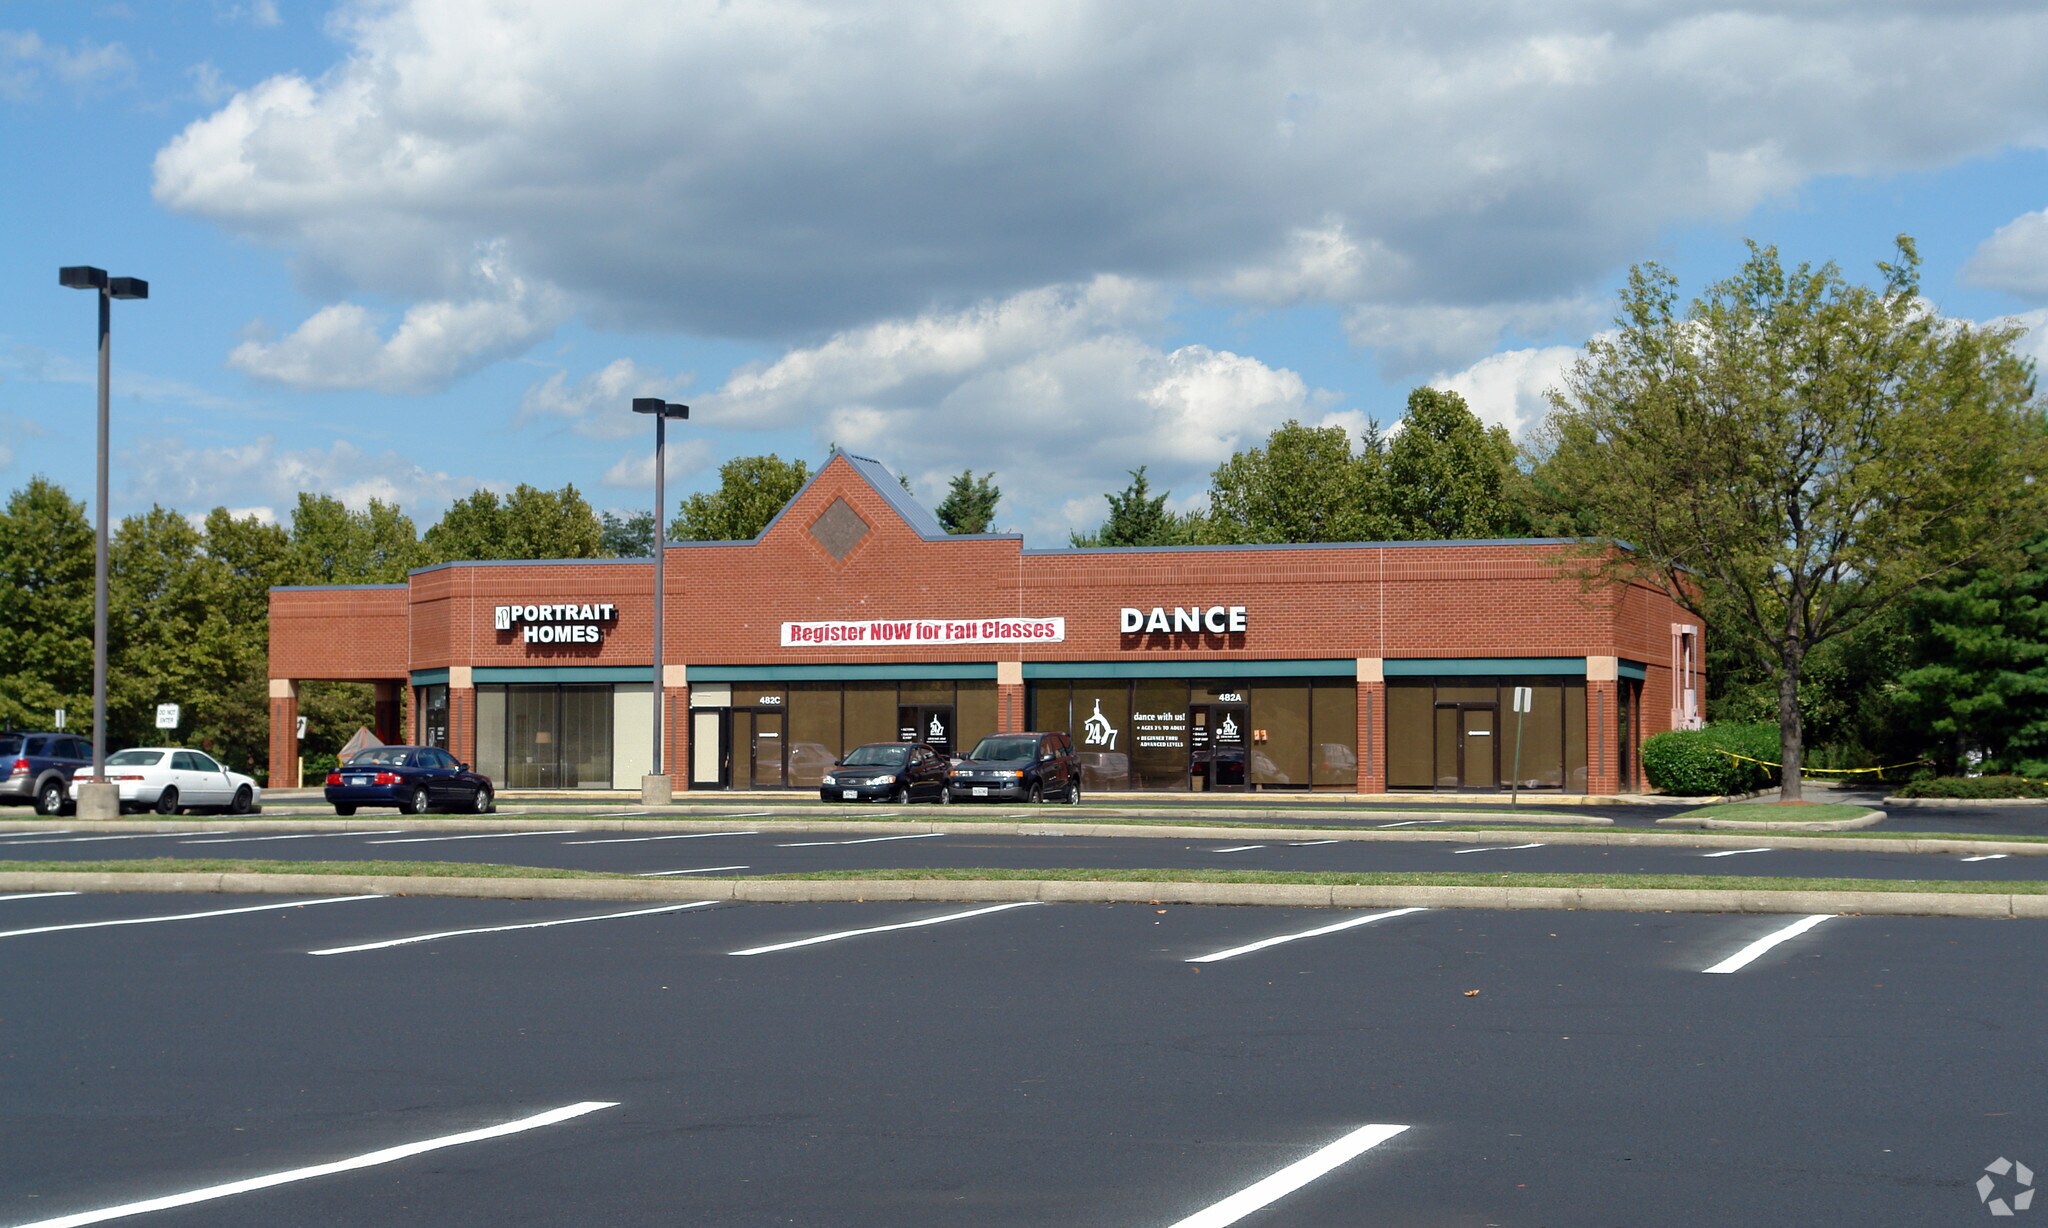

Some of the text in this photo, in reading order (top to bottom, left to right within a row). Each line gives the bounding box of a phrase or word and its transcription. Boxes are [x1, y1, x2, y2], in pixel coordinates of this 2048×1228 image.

[511, 603, 614, 621] PORTRAIT
[1120, 606, 1246, 633] DANCE
[523, 625, 600, 643] HOMES
[791, 621, 1055, 643] Register NOW for Fall Classes
[759, 696, 781, 705] 482C
[1218, 693, 1242, 702] 482A
[1133, 711, 1186, 721] dance with us!
[1085, 723, 1101, 744] 24
